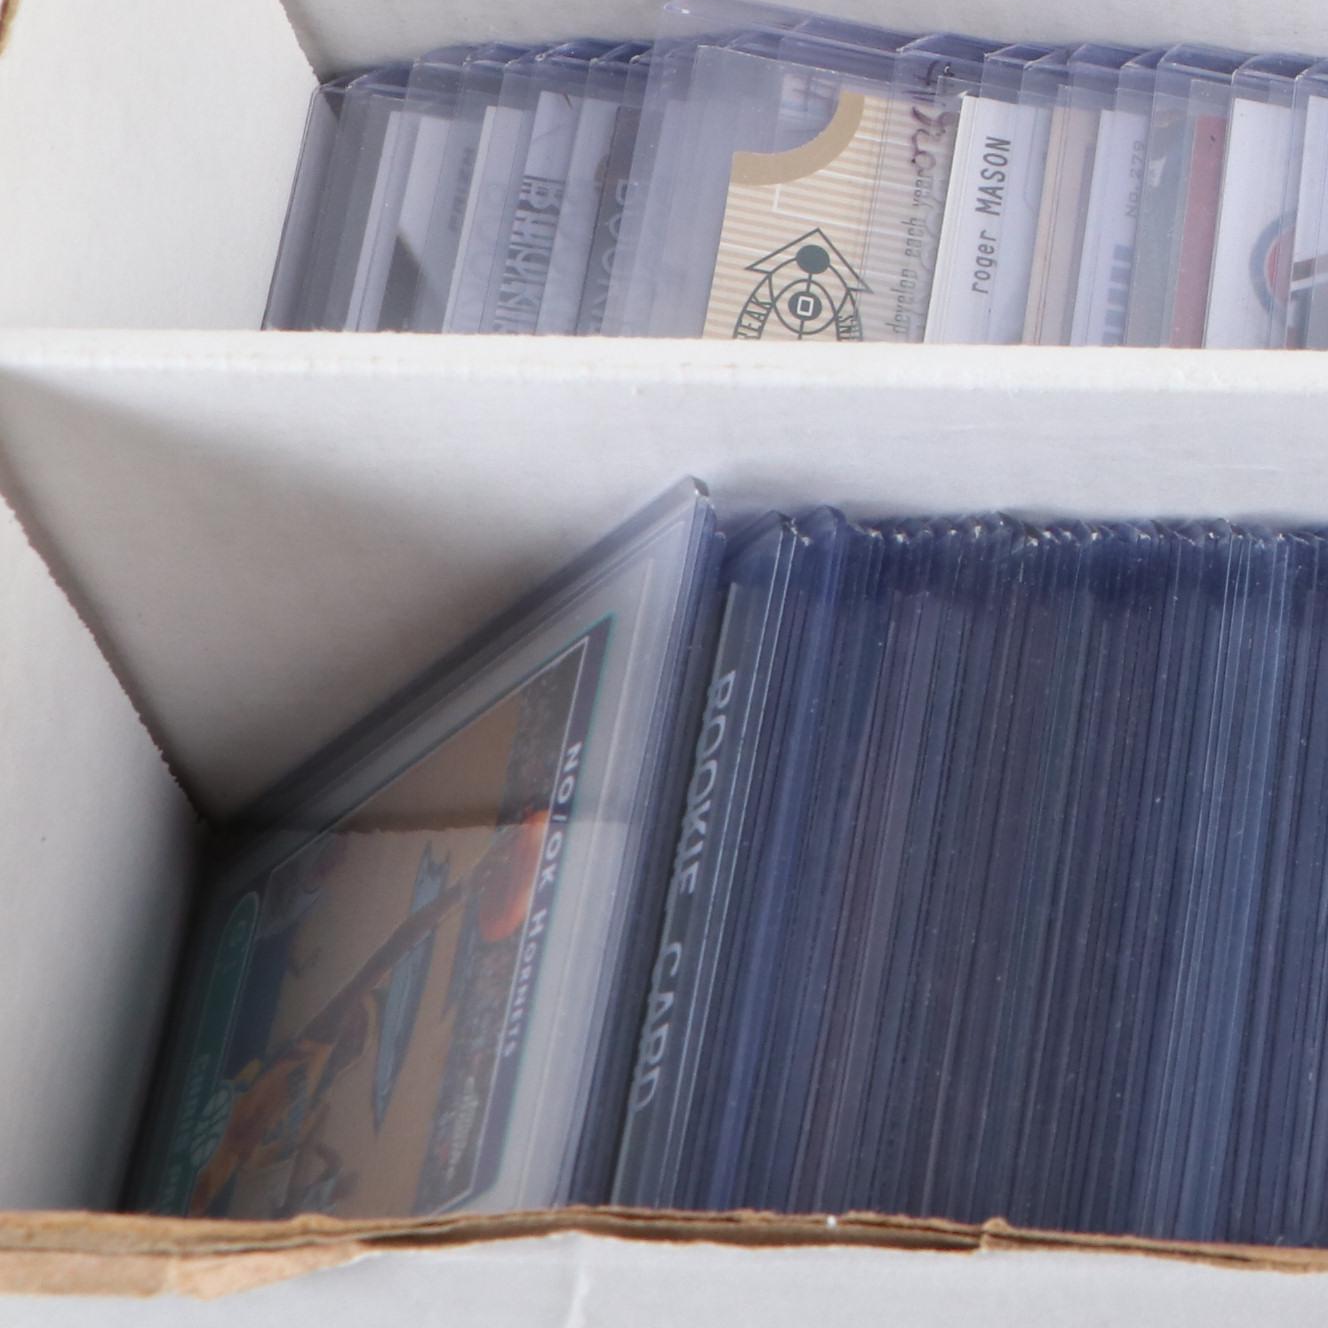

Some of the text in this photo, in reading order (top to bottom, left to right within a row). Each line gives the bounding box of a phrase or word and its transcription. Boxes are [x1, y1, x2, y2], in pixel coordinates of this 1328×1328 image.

[901, 216, 924, 258] each
[971, 135, 1012, 295] roger MASON
